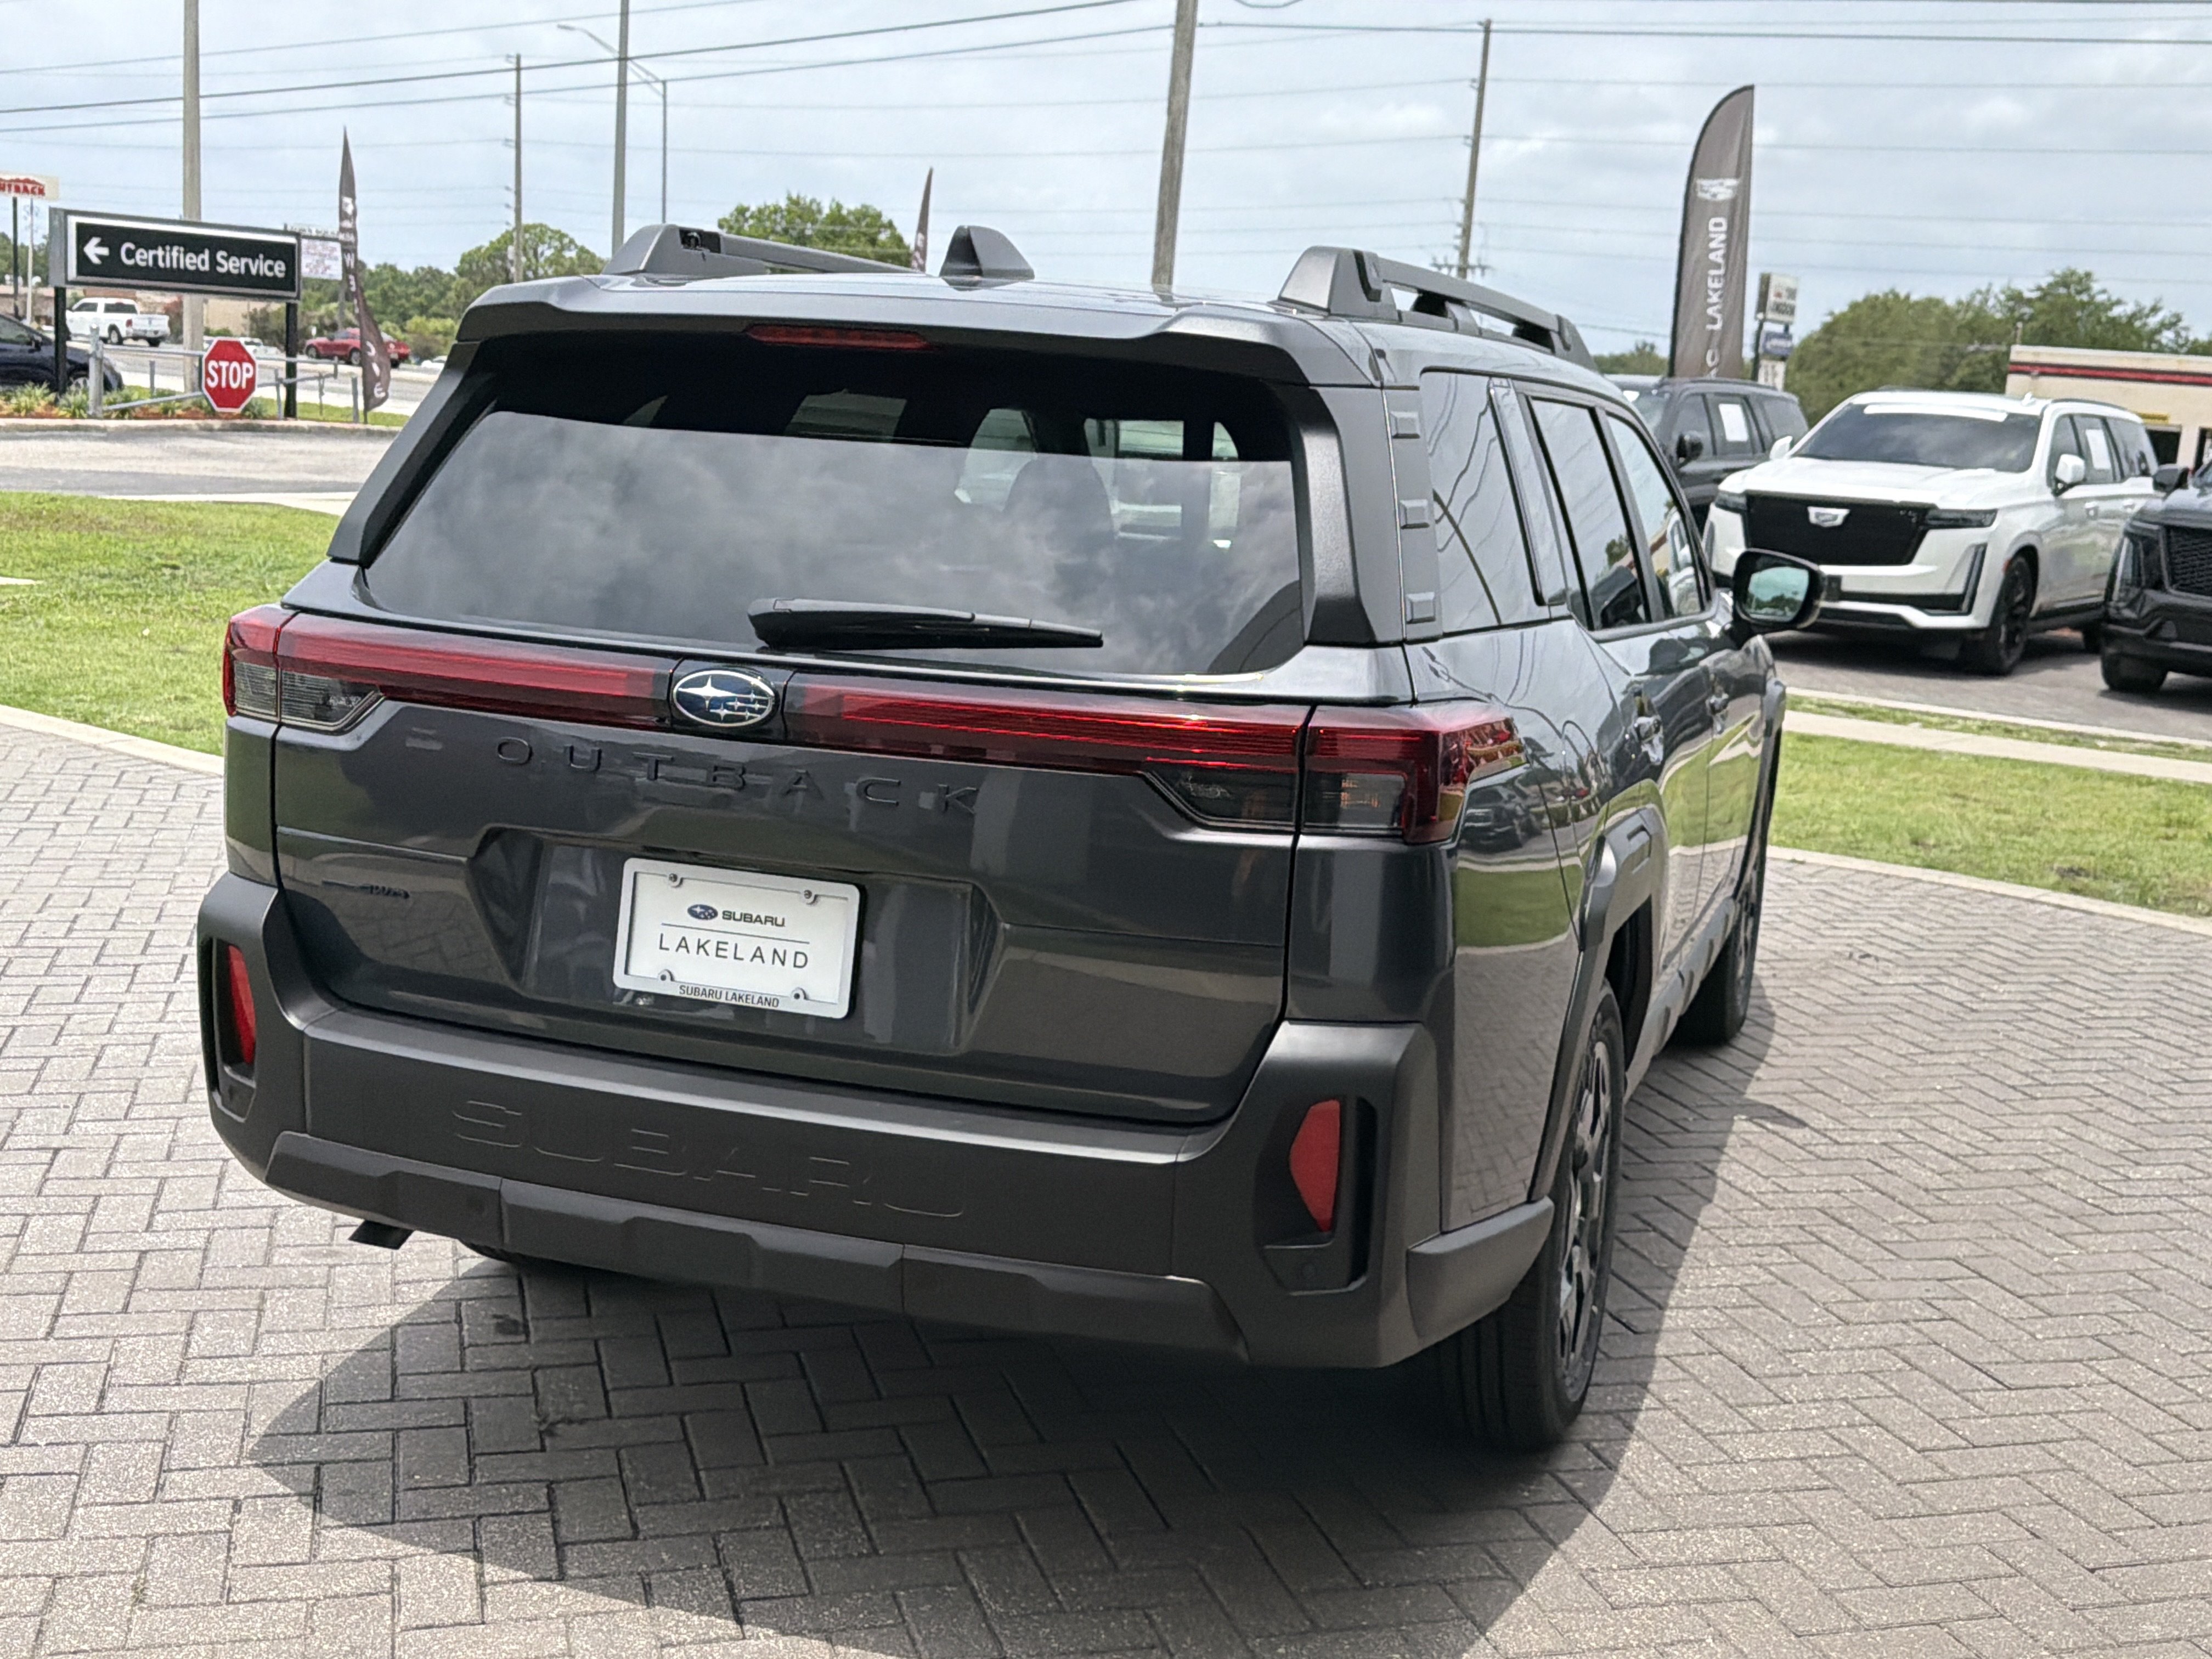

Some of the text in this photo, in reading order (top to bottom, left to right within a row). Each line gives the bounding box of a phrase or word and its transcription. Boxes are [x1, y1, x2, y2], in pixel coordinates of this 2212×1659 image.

[0, 183, 46, 196] UTBACK
[120, 242, 210, 271] Certified
[216, 250, 286, 278] Service
[1706, 217, 1728, 330] LAKELAND
[206, 360, 253, 389] STOP
[496, 736, 978, 815] OUTBACK
[721, 910, 786, 927] SUBARU
[659, 933, 809, 969] LAKELAND
[679, 985, 780, 1008] SUBARU LAKELAND
